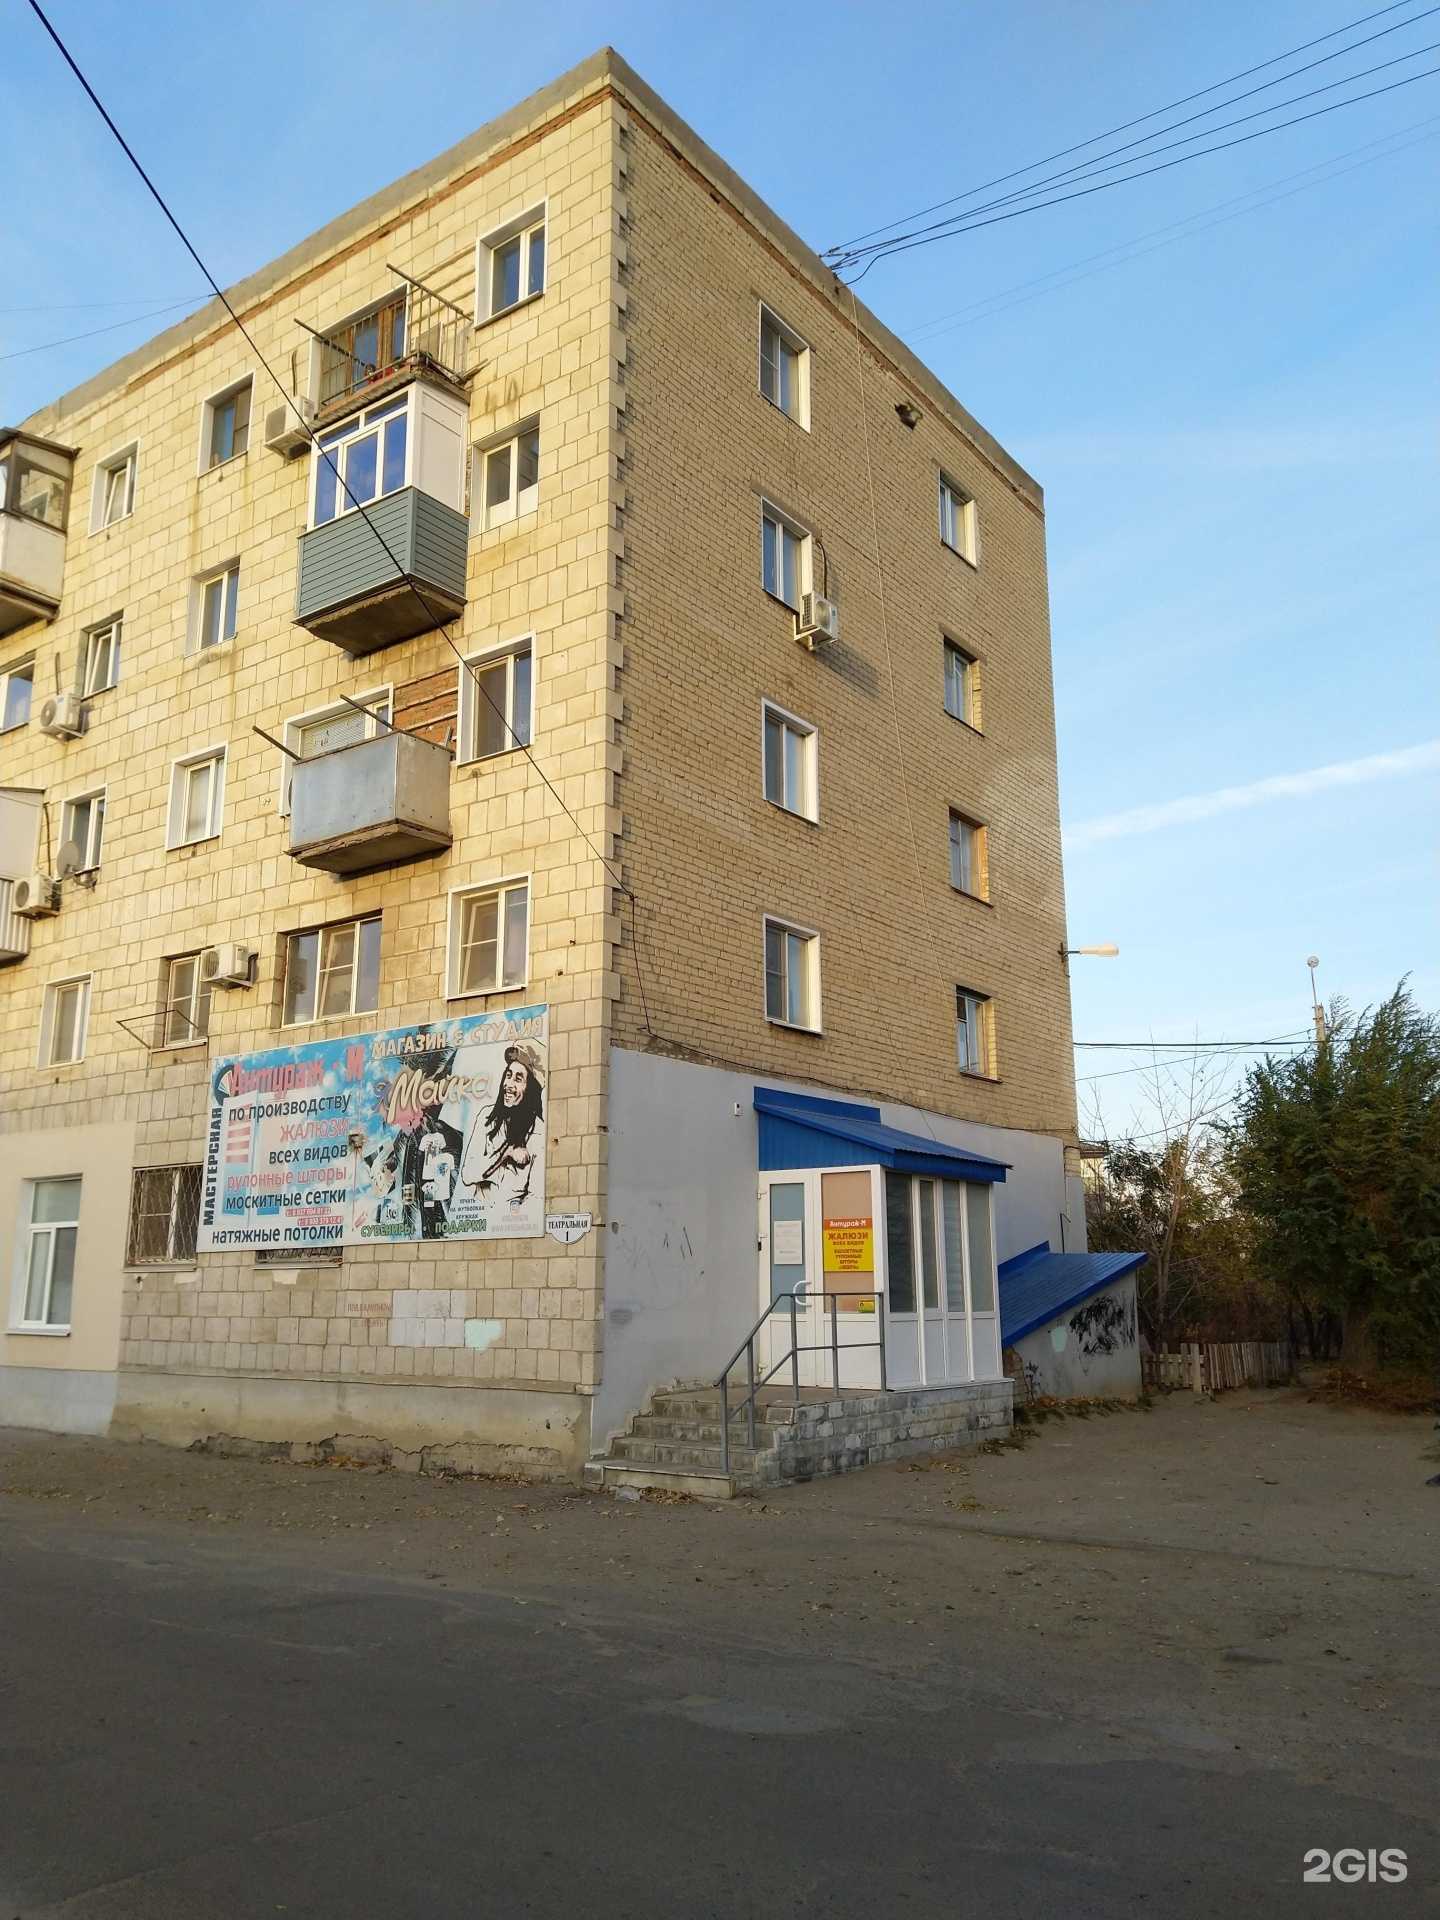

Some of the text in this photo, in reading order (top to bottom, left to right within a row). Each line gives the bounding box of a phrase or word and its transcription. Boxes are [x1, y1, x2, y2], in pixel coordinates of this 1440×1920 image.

[372, 1031, 448, 1058] МАГАЗИН
[470, 1016, 545, 1044] СТУДИЯ
[229, 1094, 352, 1122] по производству
[280, 1117, 349, 1142] ЖАЛЮЗИ
[269, 1144, 348, 1164] всех видов
[227, 1166, 347, 1192] рулонные шторы
[225, 1189, 346, 1210] москитные сетки
[212, 1225, 344, 1244] натяжные потолки
[361, 1224, 416, 1237] СУВЕНИРЫ
[435, 1218, 487, 1234] ПОДАРКИ
[548, 1220, 588, 1230] ТЕАТРАЛЬНАЯ
[828, 1231, 869, 1241] ЖАЛЮЗИ
